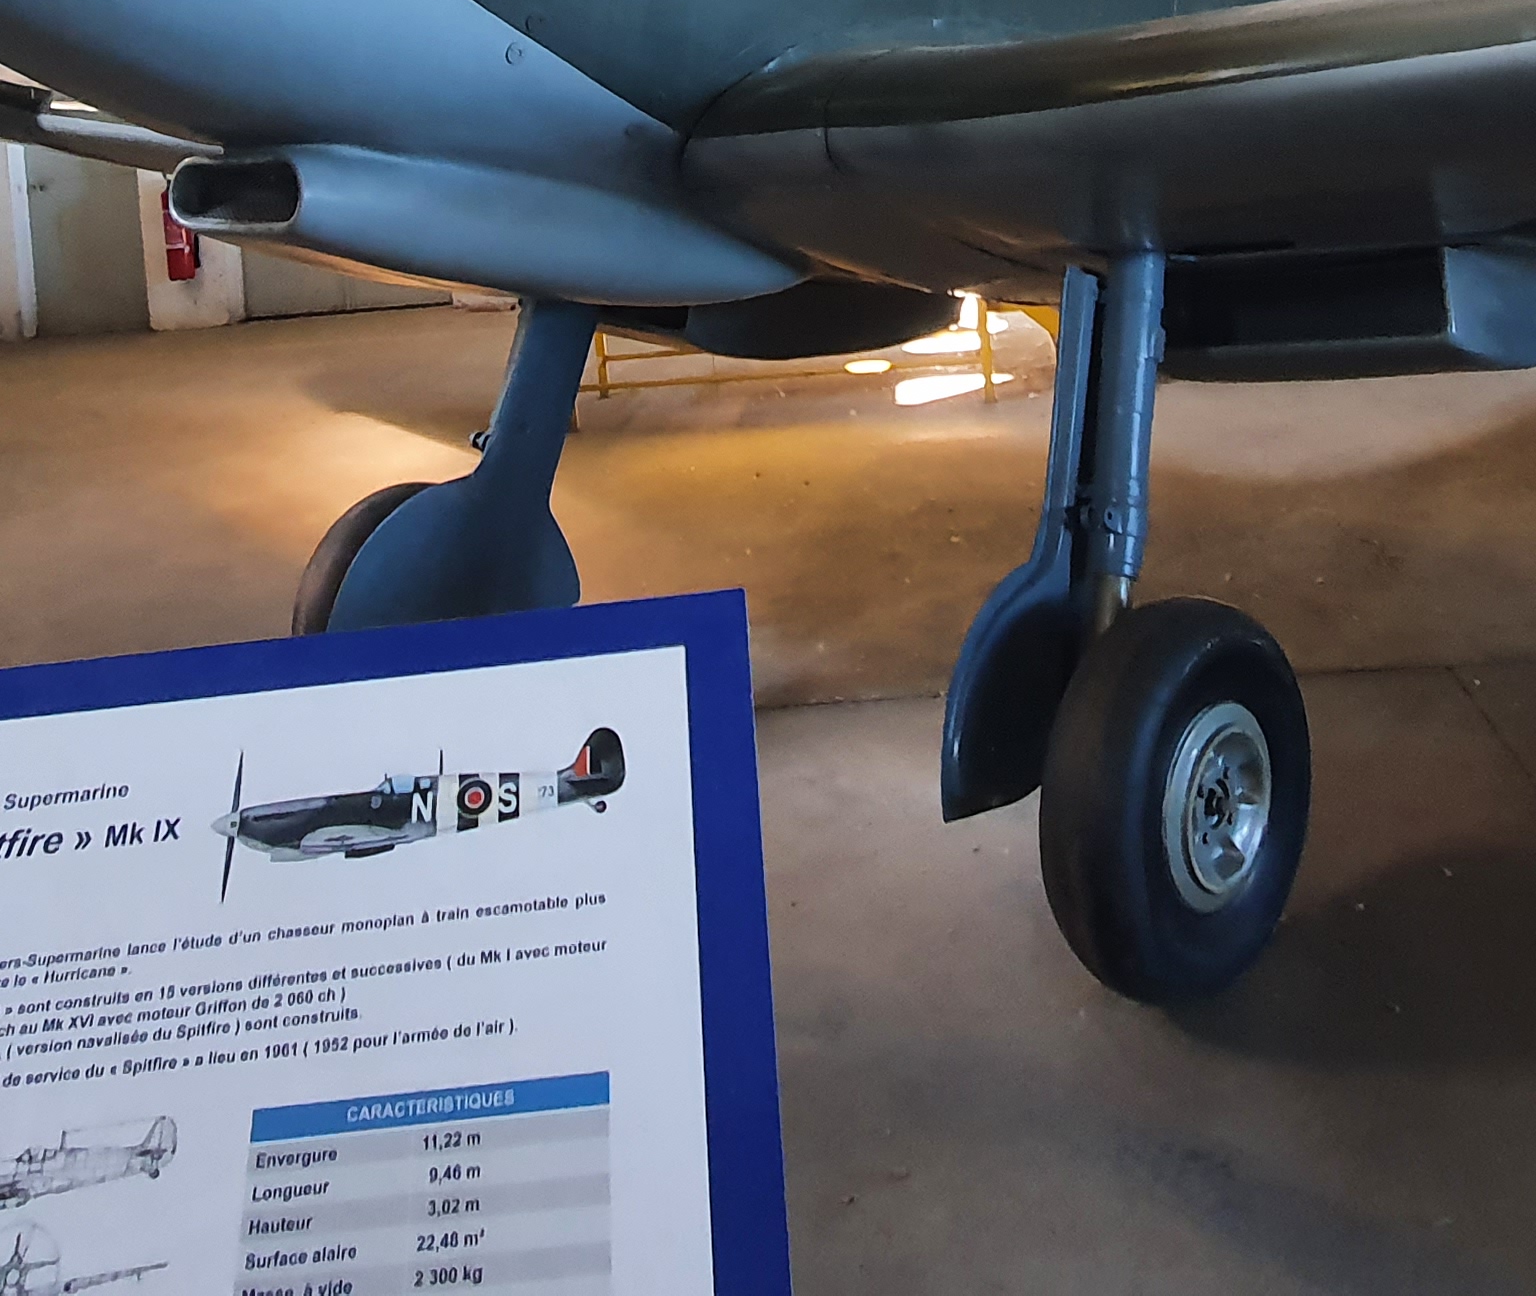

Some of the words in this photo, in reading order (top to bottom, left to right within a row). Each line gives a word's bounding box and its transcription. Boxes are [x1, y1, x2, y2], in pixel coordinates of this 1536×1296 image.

[4, 783, 129, 811] Supermarine
[411, 791, 433, 823] N
[498, 782, 517, 813] S
[104, 822, 145, 848] Mk
[153, 817, 181, 843] IX
[127, 941, 166, 956] lance
[229, 930, 261, 946] d'un
[268, 922, 335, 941] chasseur
[341, 914, 414, 932] monoplan
[421, 910, 430, 924] à
[437, 907, 469, 923] train
[476, 896, 568, 918] escamotable
[575, 892, 606, 909] plus
[14, 974, 26, 988] le
[43, 965, 115, 984] Hurricane
[17, 1000, 51, 1015] sont
[55, 989, 129, 1010] construits
[134, 989, 153, 1002] en
[180, 979, 243, 997] versions
[248, 970, 327, 991] différentes
[332, 966, 346, 981] et
[351, 958, 442, 979] successives
[457, 952, 475, 967] du
[480, 949, 501, 964] Mk
[515, 946, 549, 961] avec
[554, 939, 607, 957] moteur
[19, 1022, 38, 1035] au
[42, 1018, 63, 1033] Mk
[68, 1014, 95, 1029] XVI
[97, 1013, 133, 1028] avec
[136, 1006, 191, 1022] moteur
[195, 999, 247, 1016] Griffon
[251, 995, 269, 1010] de
[273, 993, 283, 1008] 2
[317, 987, 335, 1002] ch
[2, 1073, 21, 1087] de
[25, 1067, 80, 1084] service
[85, 1064, 105, 1078] du
[122, 1057, 177, 1077] Spitfire
[208, 1050, 236, 1065] lieu
[240, 1049, 259, 1062] en
[353, 1033, 389, 1053] pour
[393, 1026, 449, 1046] l'armée
[453, 1023, 471, 1038] de
[476, 1019, 505, 1037] l'air
[17, 1039, 72, 1056] version
[77, 1028, 148, 1049] navalisée
[152, 1027, 172, 1041] du
[176, 1021, 231, 1040] Spitfire
[245, 1016, 278, 1031] sont
[346, 1089, 515, 1123] CARACTERISTIQUES
[255, 1149, 338, 1169] Envergure
[423, 1131, 462, 1152] 11,22
[467, 1131, 481, 1145] m
[252, 1181, 329, 1202] Longueur
[466, 1164, 481, 1178] m
[248, 1216, 313, 1236] Hauteur
[465, 1198, 480, 1212] m
[244, 1250, 307, 1271] Surface
[313, 1244, 357, 1264] alaire
[317, 1279, 353, 1296] vide
[413, 1270, 423, 1287] 2
[429, 1267, 458, 1285] 300
[463, 1265, 483, 1284] kg
